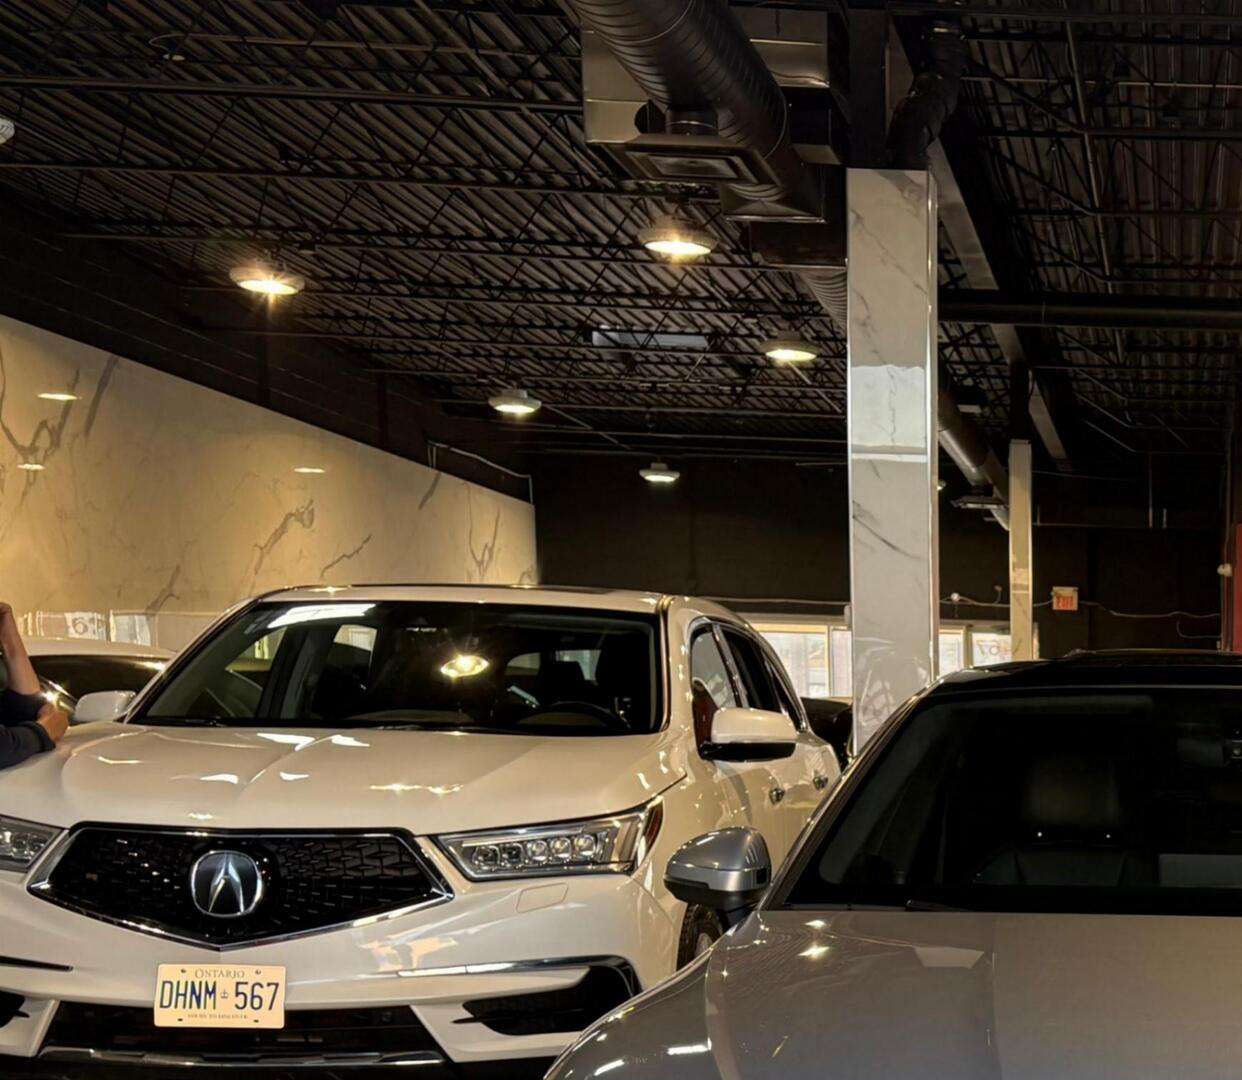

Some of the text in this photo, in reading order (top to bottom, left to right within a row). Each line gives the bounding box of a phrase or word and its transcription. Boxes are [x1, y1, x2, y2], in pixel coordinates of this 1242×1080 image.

[194, 968, 245, 979] ONTARIO
[159, 980, 280, 1011] DHNM 567
